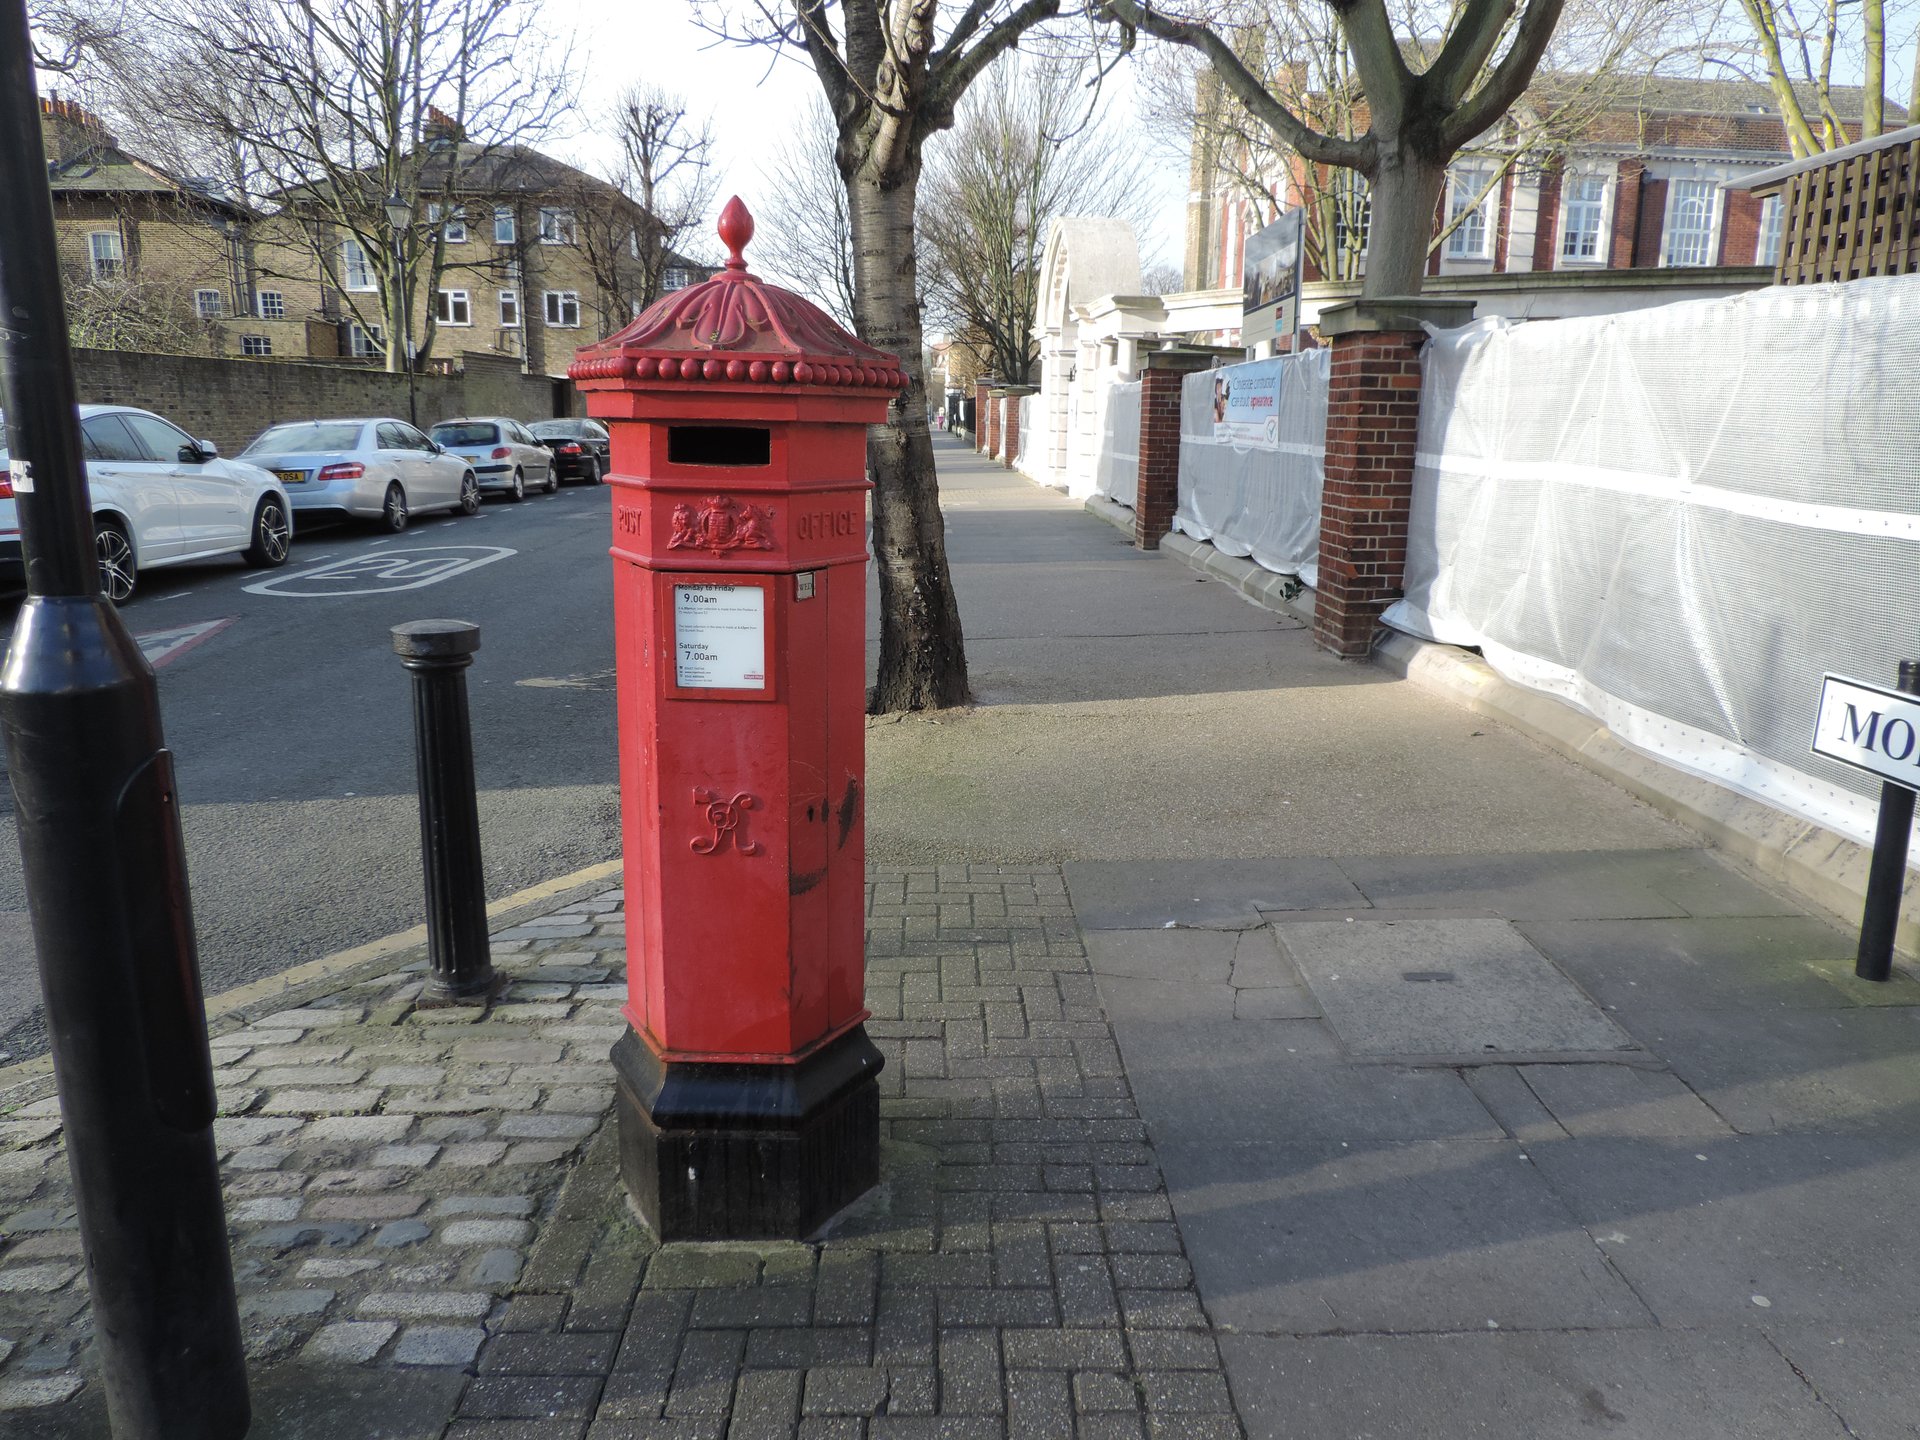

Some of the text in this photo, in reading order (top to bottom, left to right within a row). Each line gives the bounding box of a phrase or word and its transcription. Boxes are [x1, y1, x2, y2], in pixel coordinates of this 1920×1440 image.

[618, 504, 642, 536] POST
[799, 511, 857, 540] OFFICE
[304, 558, 470, 580] 20
[684, 593, 717, 603] 9.00am
[685, 651, 718, 660] 7.00am
[1837, 702, 1920, 768] MO
